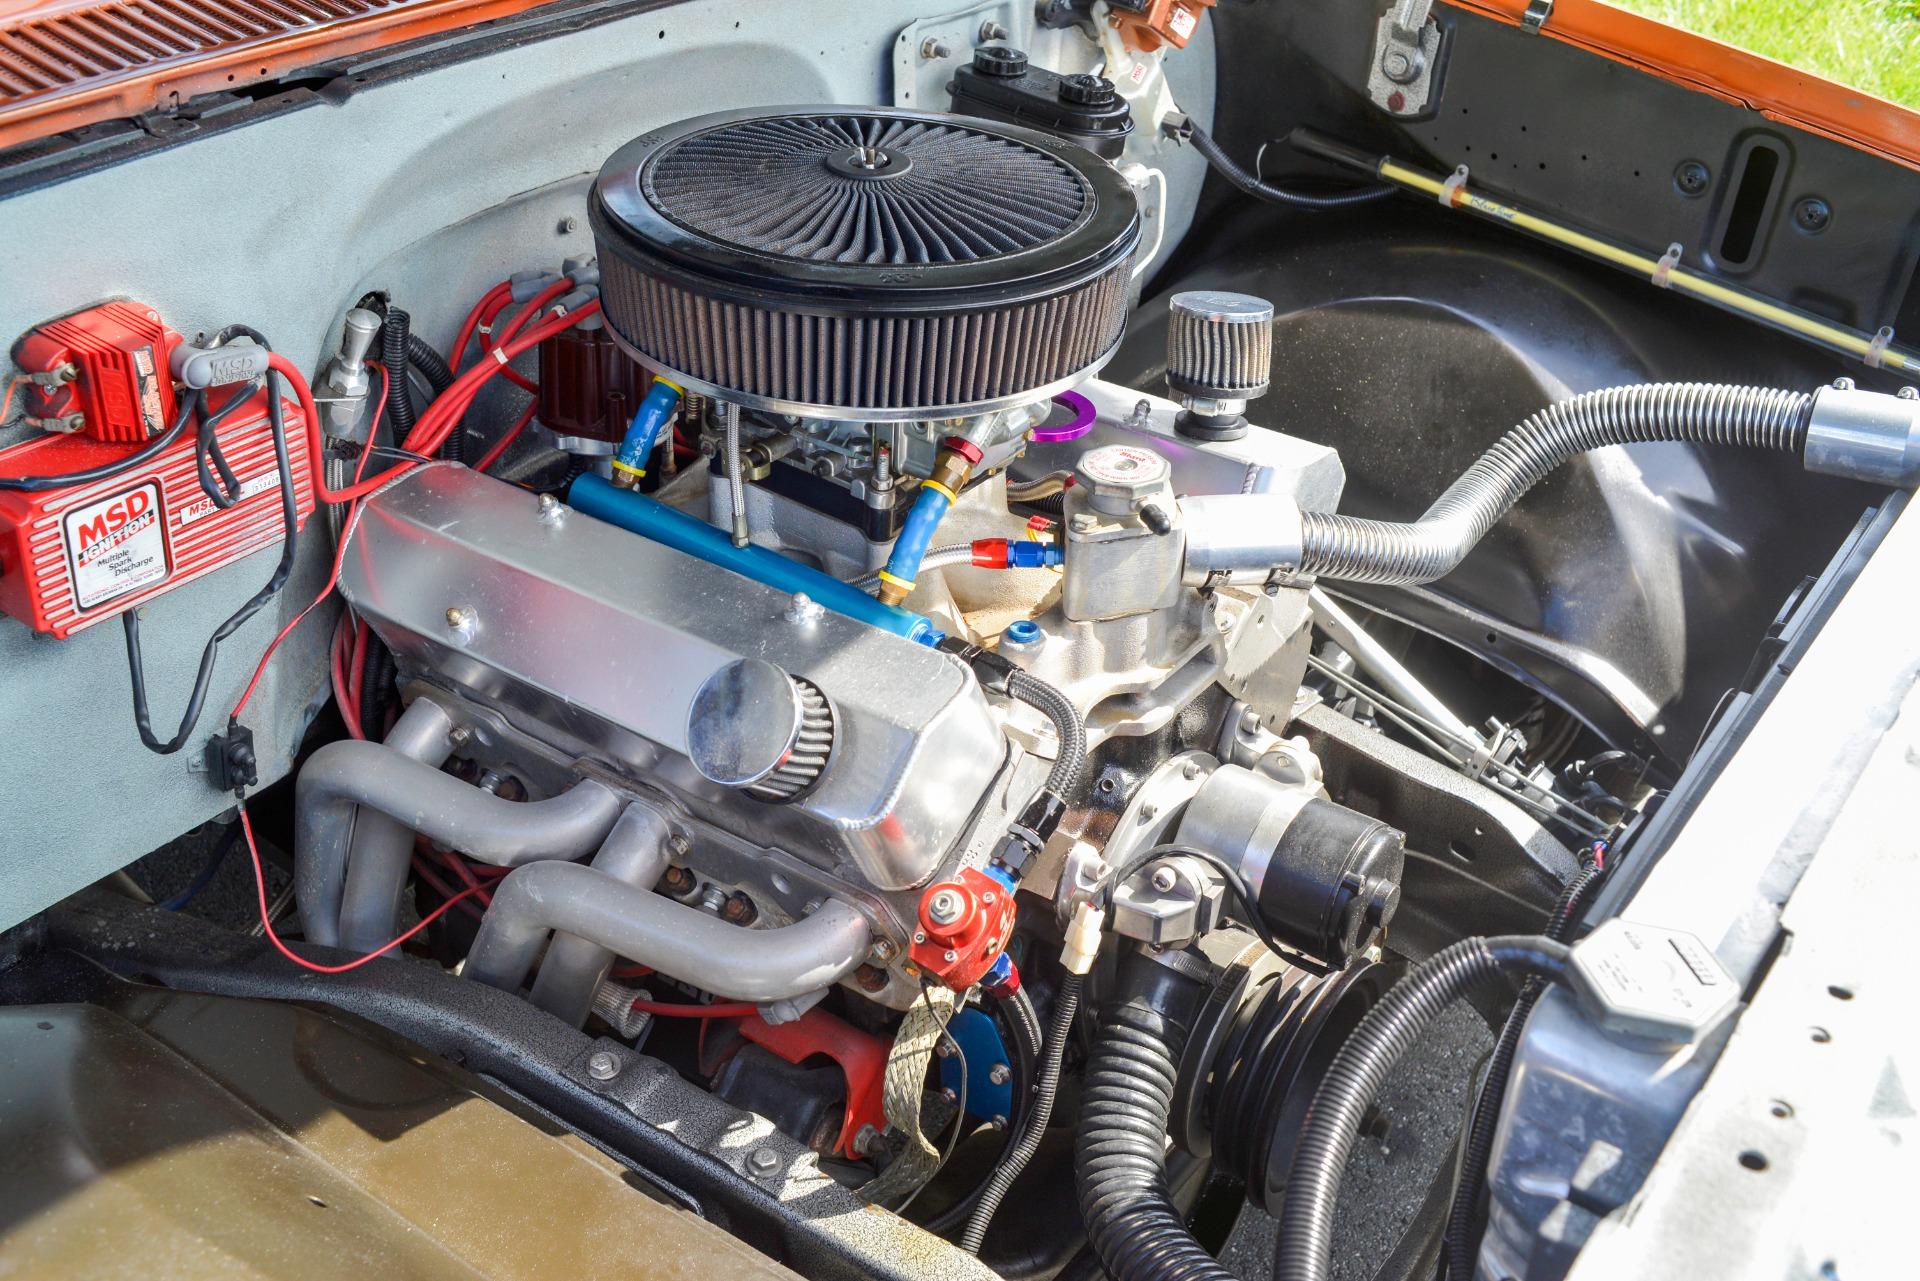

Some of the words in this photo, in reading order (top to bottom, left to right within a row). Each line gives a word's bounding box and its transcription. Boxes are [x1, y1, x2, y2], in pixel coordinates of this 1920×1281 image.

[78, 490, 149, 550] MSD
[80, 510, 153, 566] IGNITION
[97, 549, 129, 567] Multiple
[108, 557, 132, 571] Spark
[114, 556, 154, 577] Discharge
